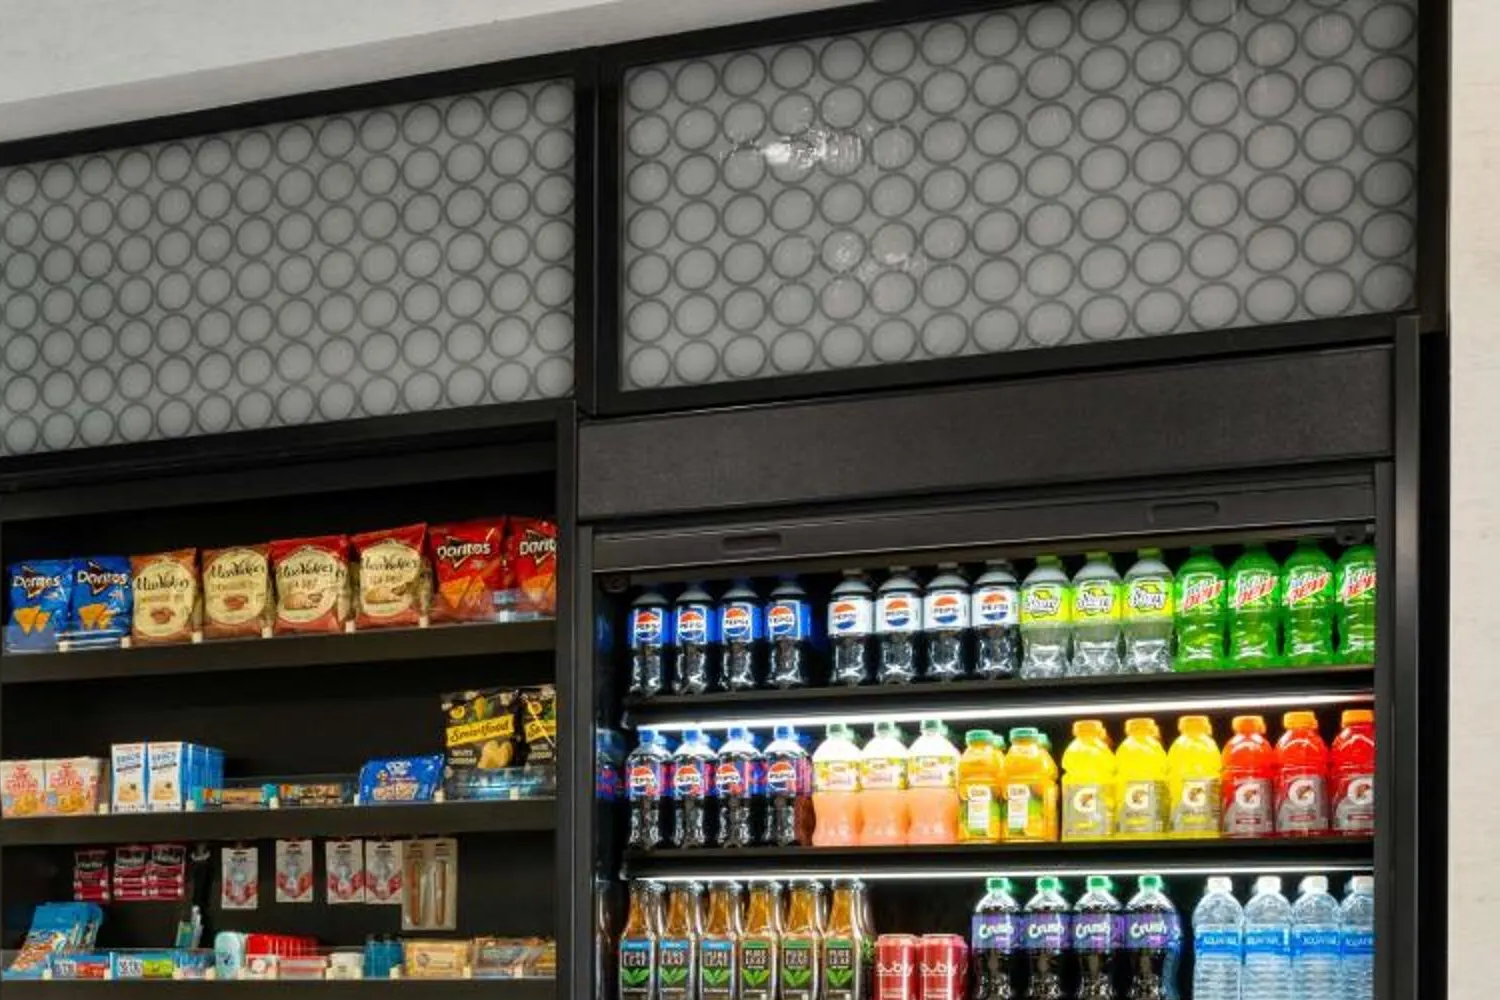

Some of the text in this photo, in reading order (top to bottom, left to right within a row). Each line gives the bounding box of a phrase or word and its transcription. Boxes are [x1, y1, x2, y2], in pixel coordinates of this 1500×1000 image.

[437, 543, 491, 560] Doritos
[77, 570, 128, 585] Doritos
[1130, 920, 1168, 938] Crush
